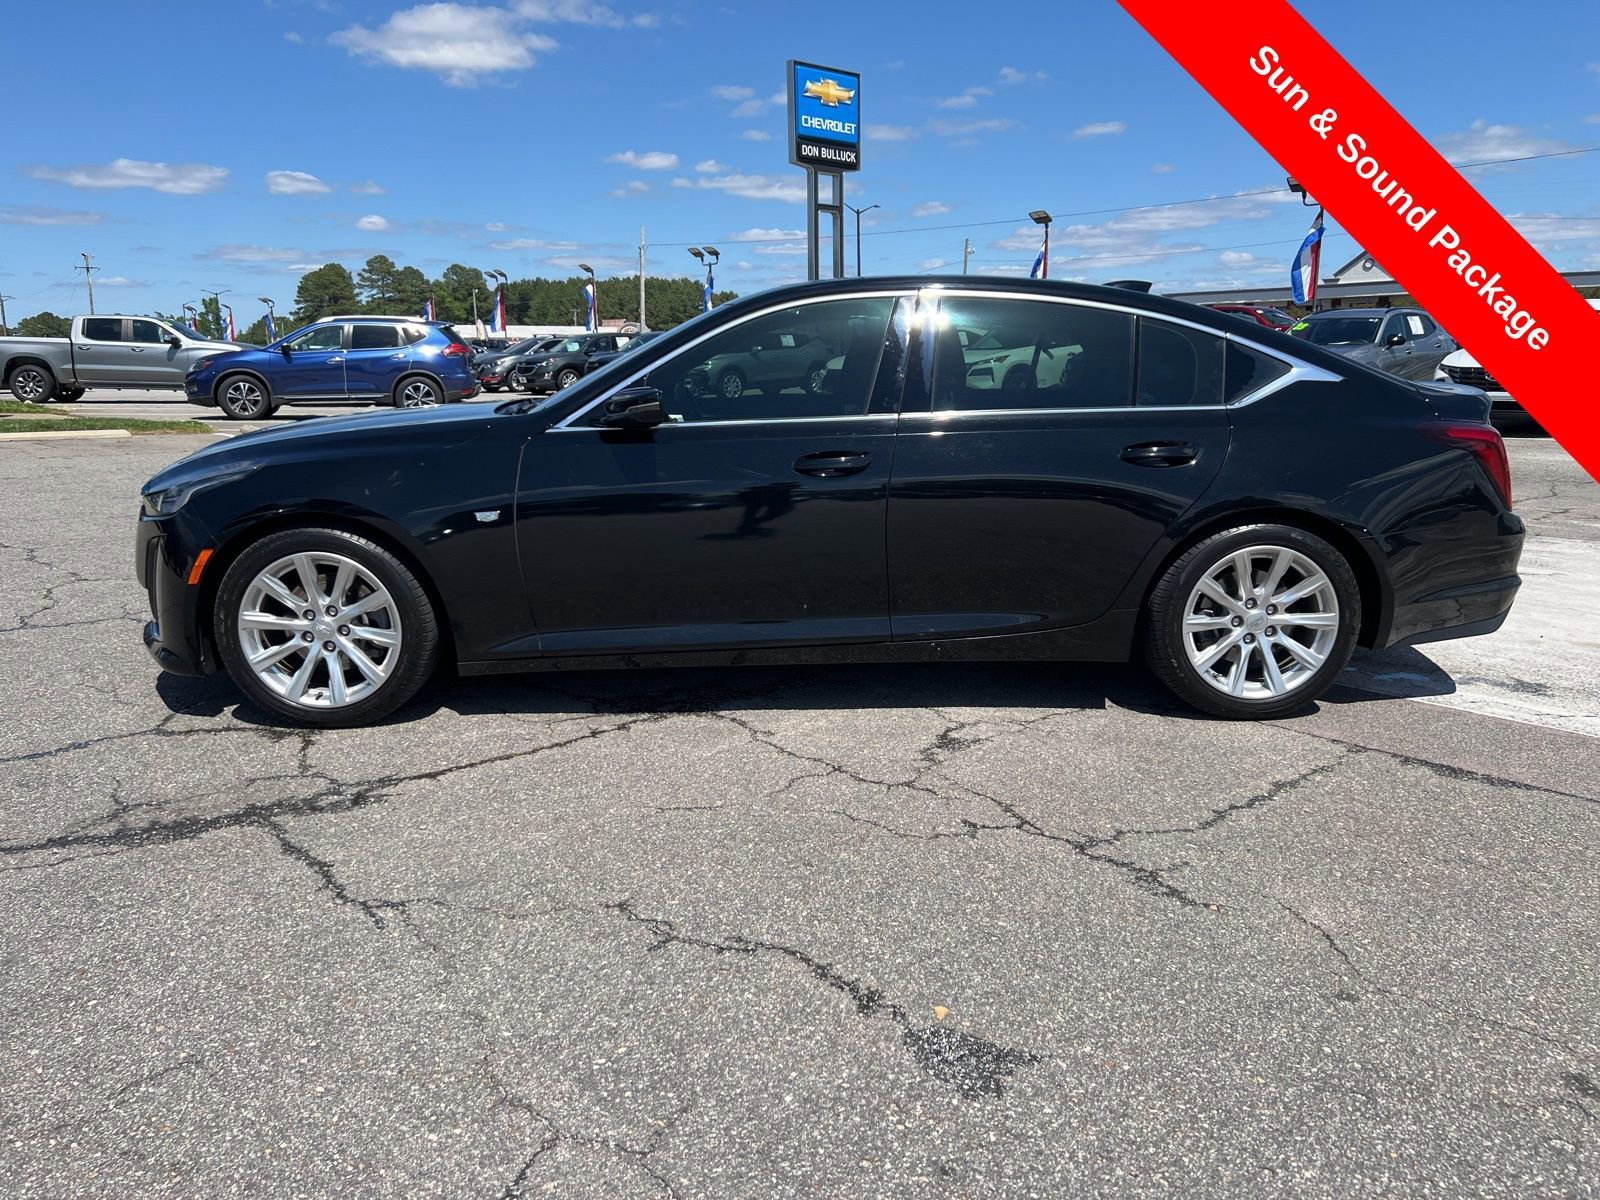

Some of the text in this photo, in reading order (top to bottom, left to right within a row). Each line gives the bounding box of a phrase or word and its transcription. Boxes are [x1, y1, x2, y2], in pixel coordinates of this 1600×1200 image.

[801, 115, 856, 135] CHEVROLET
[801, 144, 857, 163] DON BULLUCK
